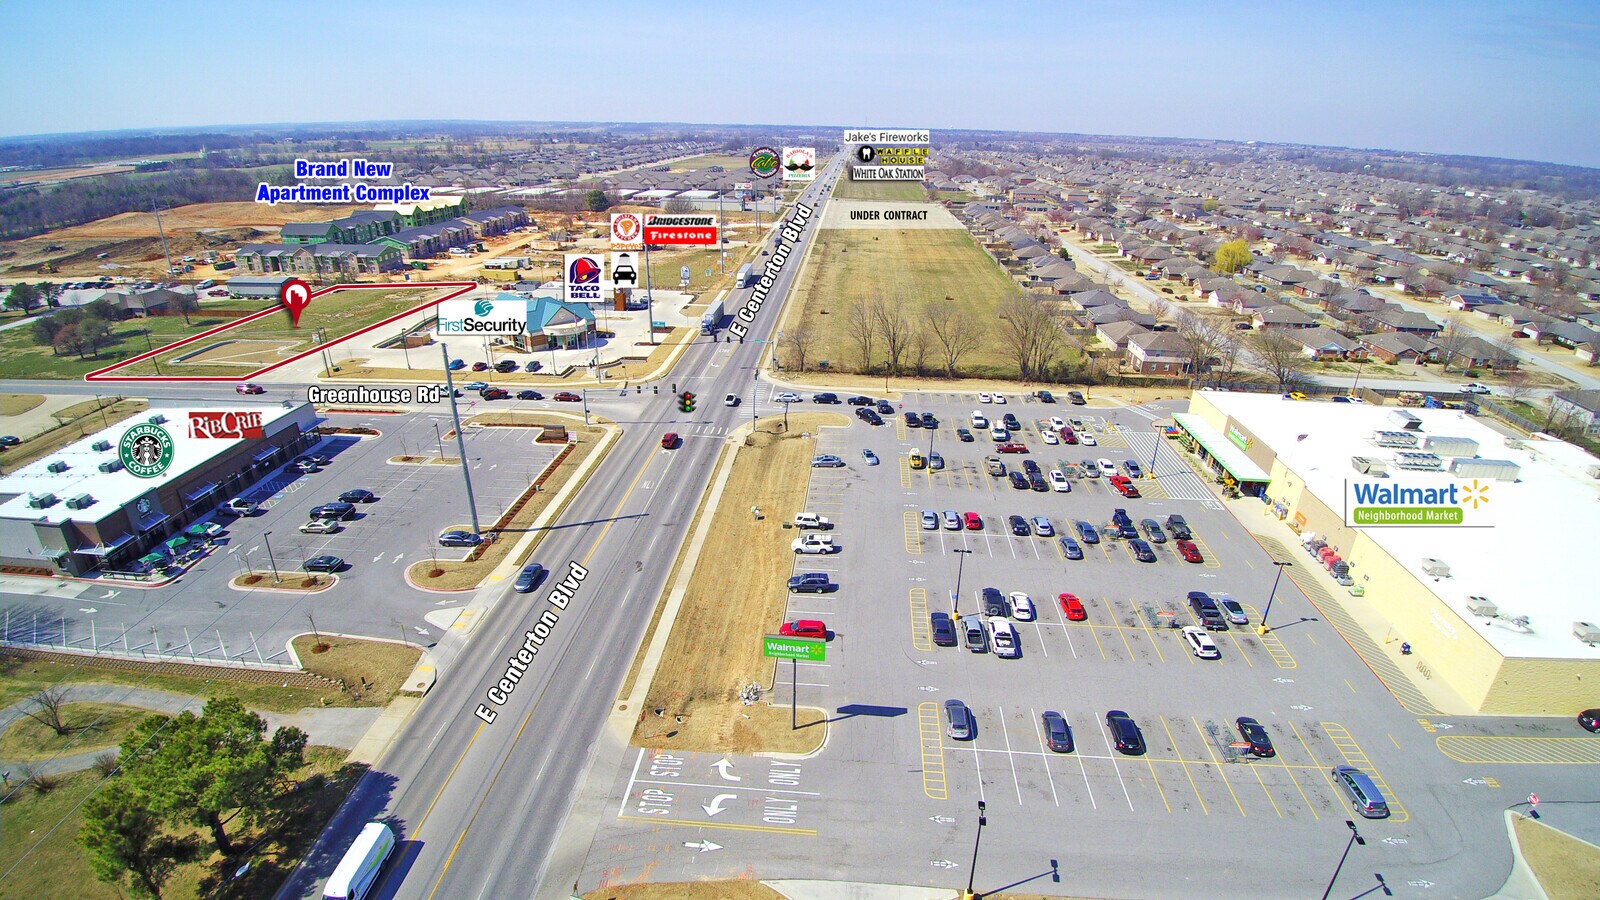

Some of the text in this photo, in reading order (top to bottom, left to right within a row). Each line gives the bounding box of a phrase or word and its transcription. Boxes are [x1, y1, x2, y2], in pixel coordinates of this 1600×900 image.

[767, 642, 810, 653] Walmart
[649, 754, 684, 777] STOP
[768, 760, 802, 786] ONLY
[637, 788, 675, 815] STOP
[762, 796, 798, 824] ONLY
